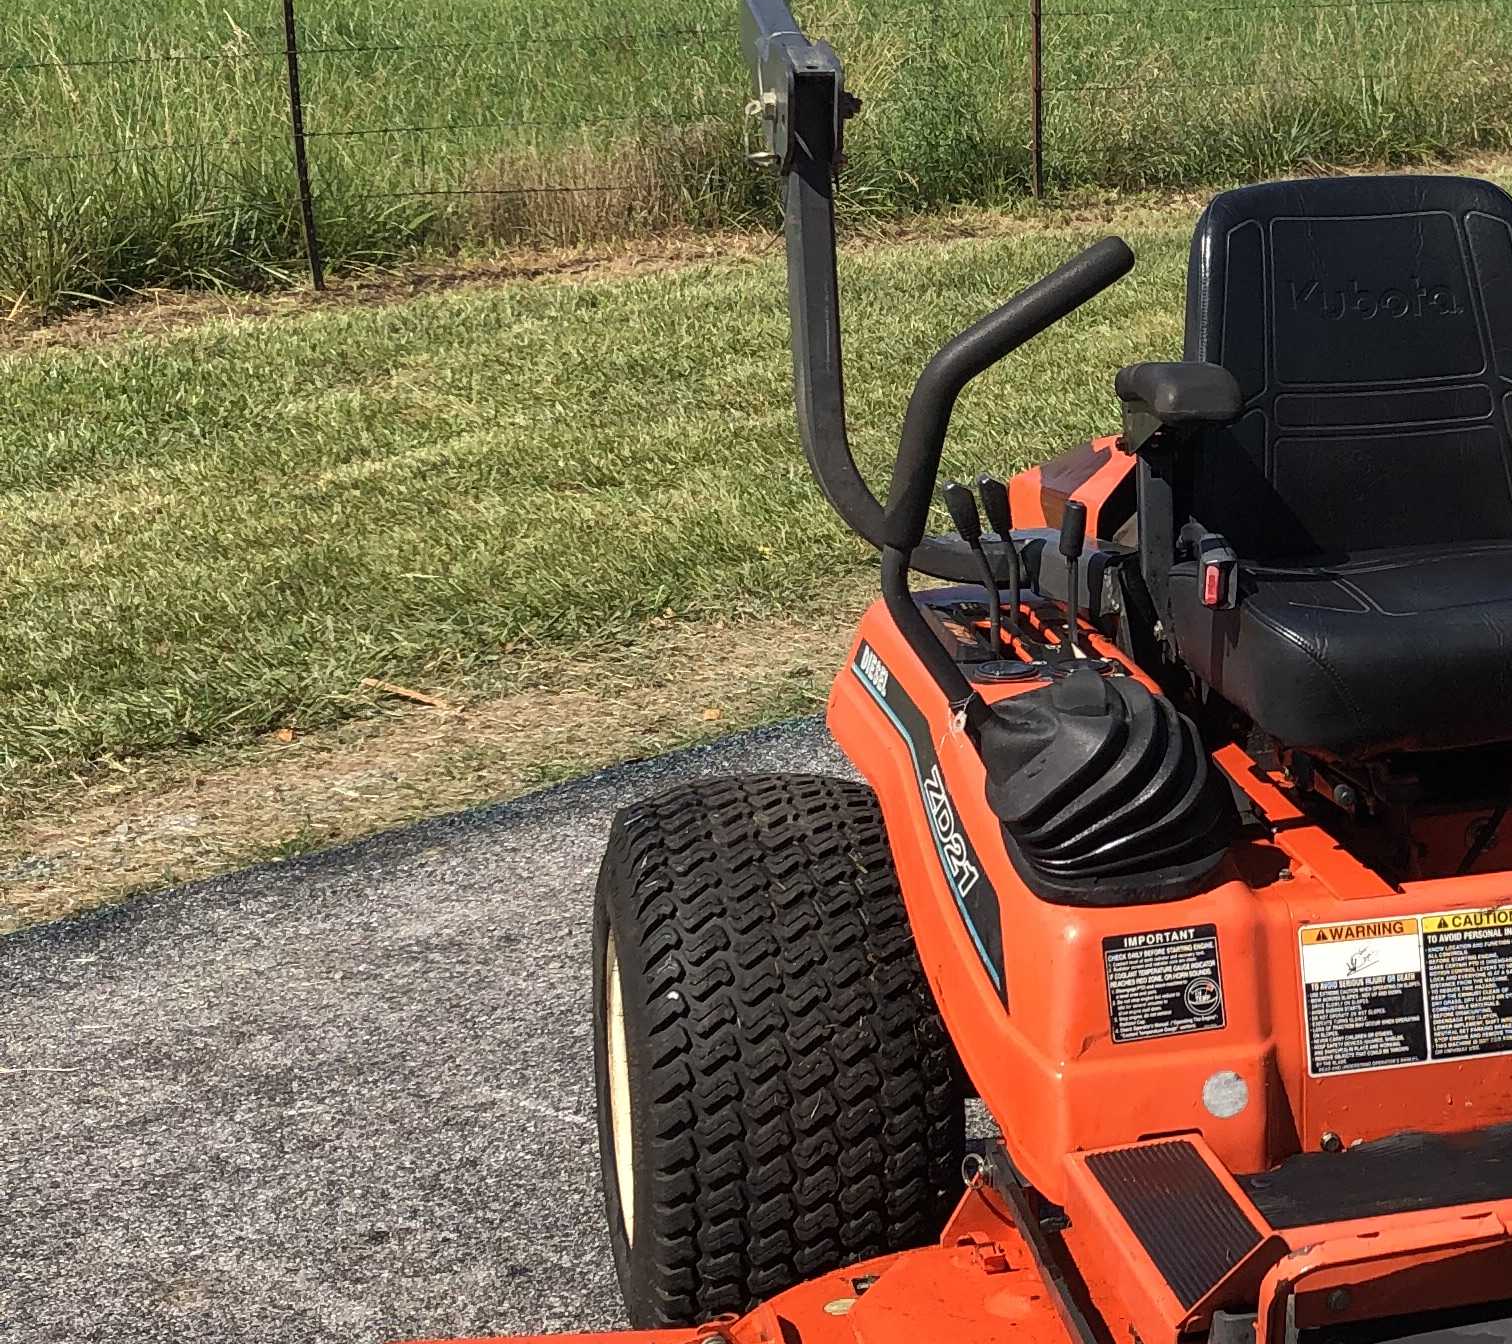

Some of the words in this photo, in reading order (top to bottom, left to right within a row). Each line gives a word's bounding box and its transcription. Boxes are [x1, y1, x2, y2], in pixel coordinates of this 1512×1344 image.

[1286, 278, 1464, 320] Kubota
[860, 644, 889, 698] DIESEL
[924, 764, 980, 898] ZD21
[1124, 929, 1196, 947] IMPORTANT
[1329, 921, 1404, 940] WARNING
[1427, 935, 1437, 944] TO
[1439, 932, 1462, 943] AVOID
[1464, 928, 1502, 940] PERSONAL
